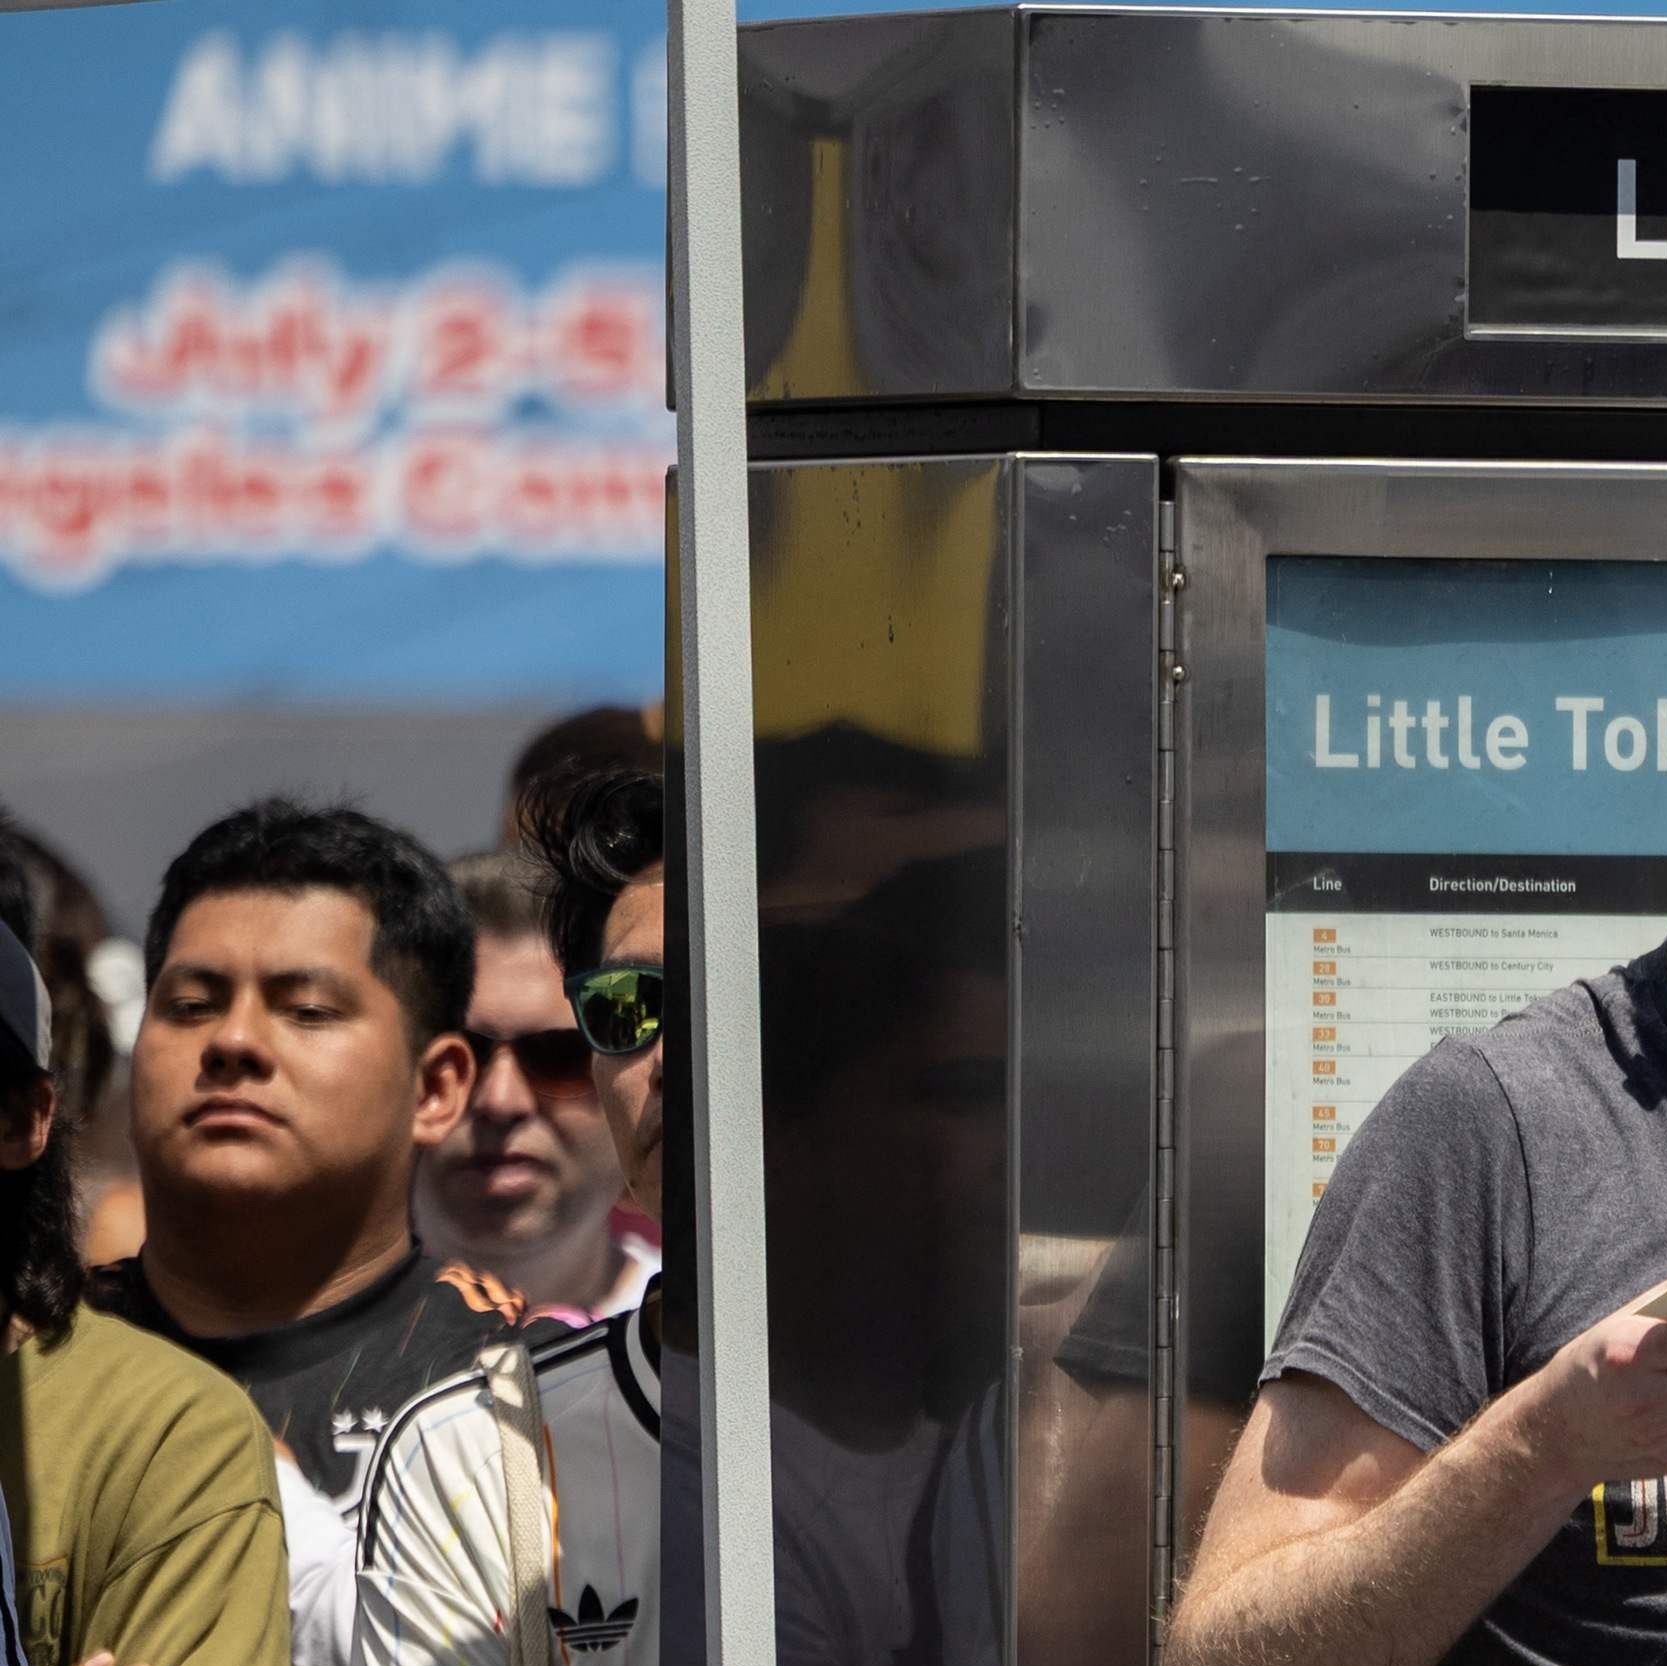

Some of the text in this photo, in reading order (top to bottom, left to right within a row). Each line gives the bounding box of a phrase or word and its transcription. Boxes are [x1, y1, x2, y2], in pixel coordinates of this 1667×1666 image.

[150, 32, 612, 186] ANIME
[100, 272, 385, 425] July
[1313, 694, 1529, 772] Little
[1313, 877, 1577, 894] Line Direction/Destination
[1429, 928, 1559, 939] WESTBOUND to Santa Monica
[1313, 945, 1351, 955] Metro Bus
[1429, 961, 1555, 973] WESTBOUND to Century City
[1313, 977, 1351, 987] Metro Bus
[1429, 993, 1488, 1004] EASTBOUND
[1489, 993, 1498, 1004] to
[1499, 993, 1523, 1004] Little
[1313, 1011, 1351, 1021] Metro Bus
[1429, 1009, 1489, 1019] WESTBOUND
[1490, 1009, 1500, 1019] to
[1313, 1043, 1351, 1053] Metro Bus
[1313, 1077, 1351, 1086] Metro Bus
[1313, 1122, 1351, 1132] Metro Bus
[1313, 1155, 1335, 1164] Metro
